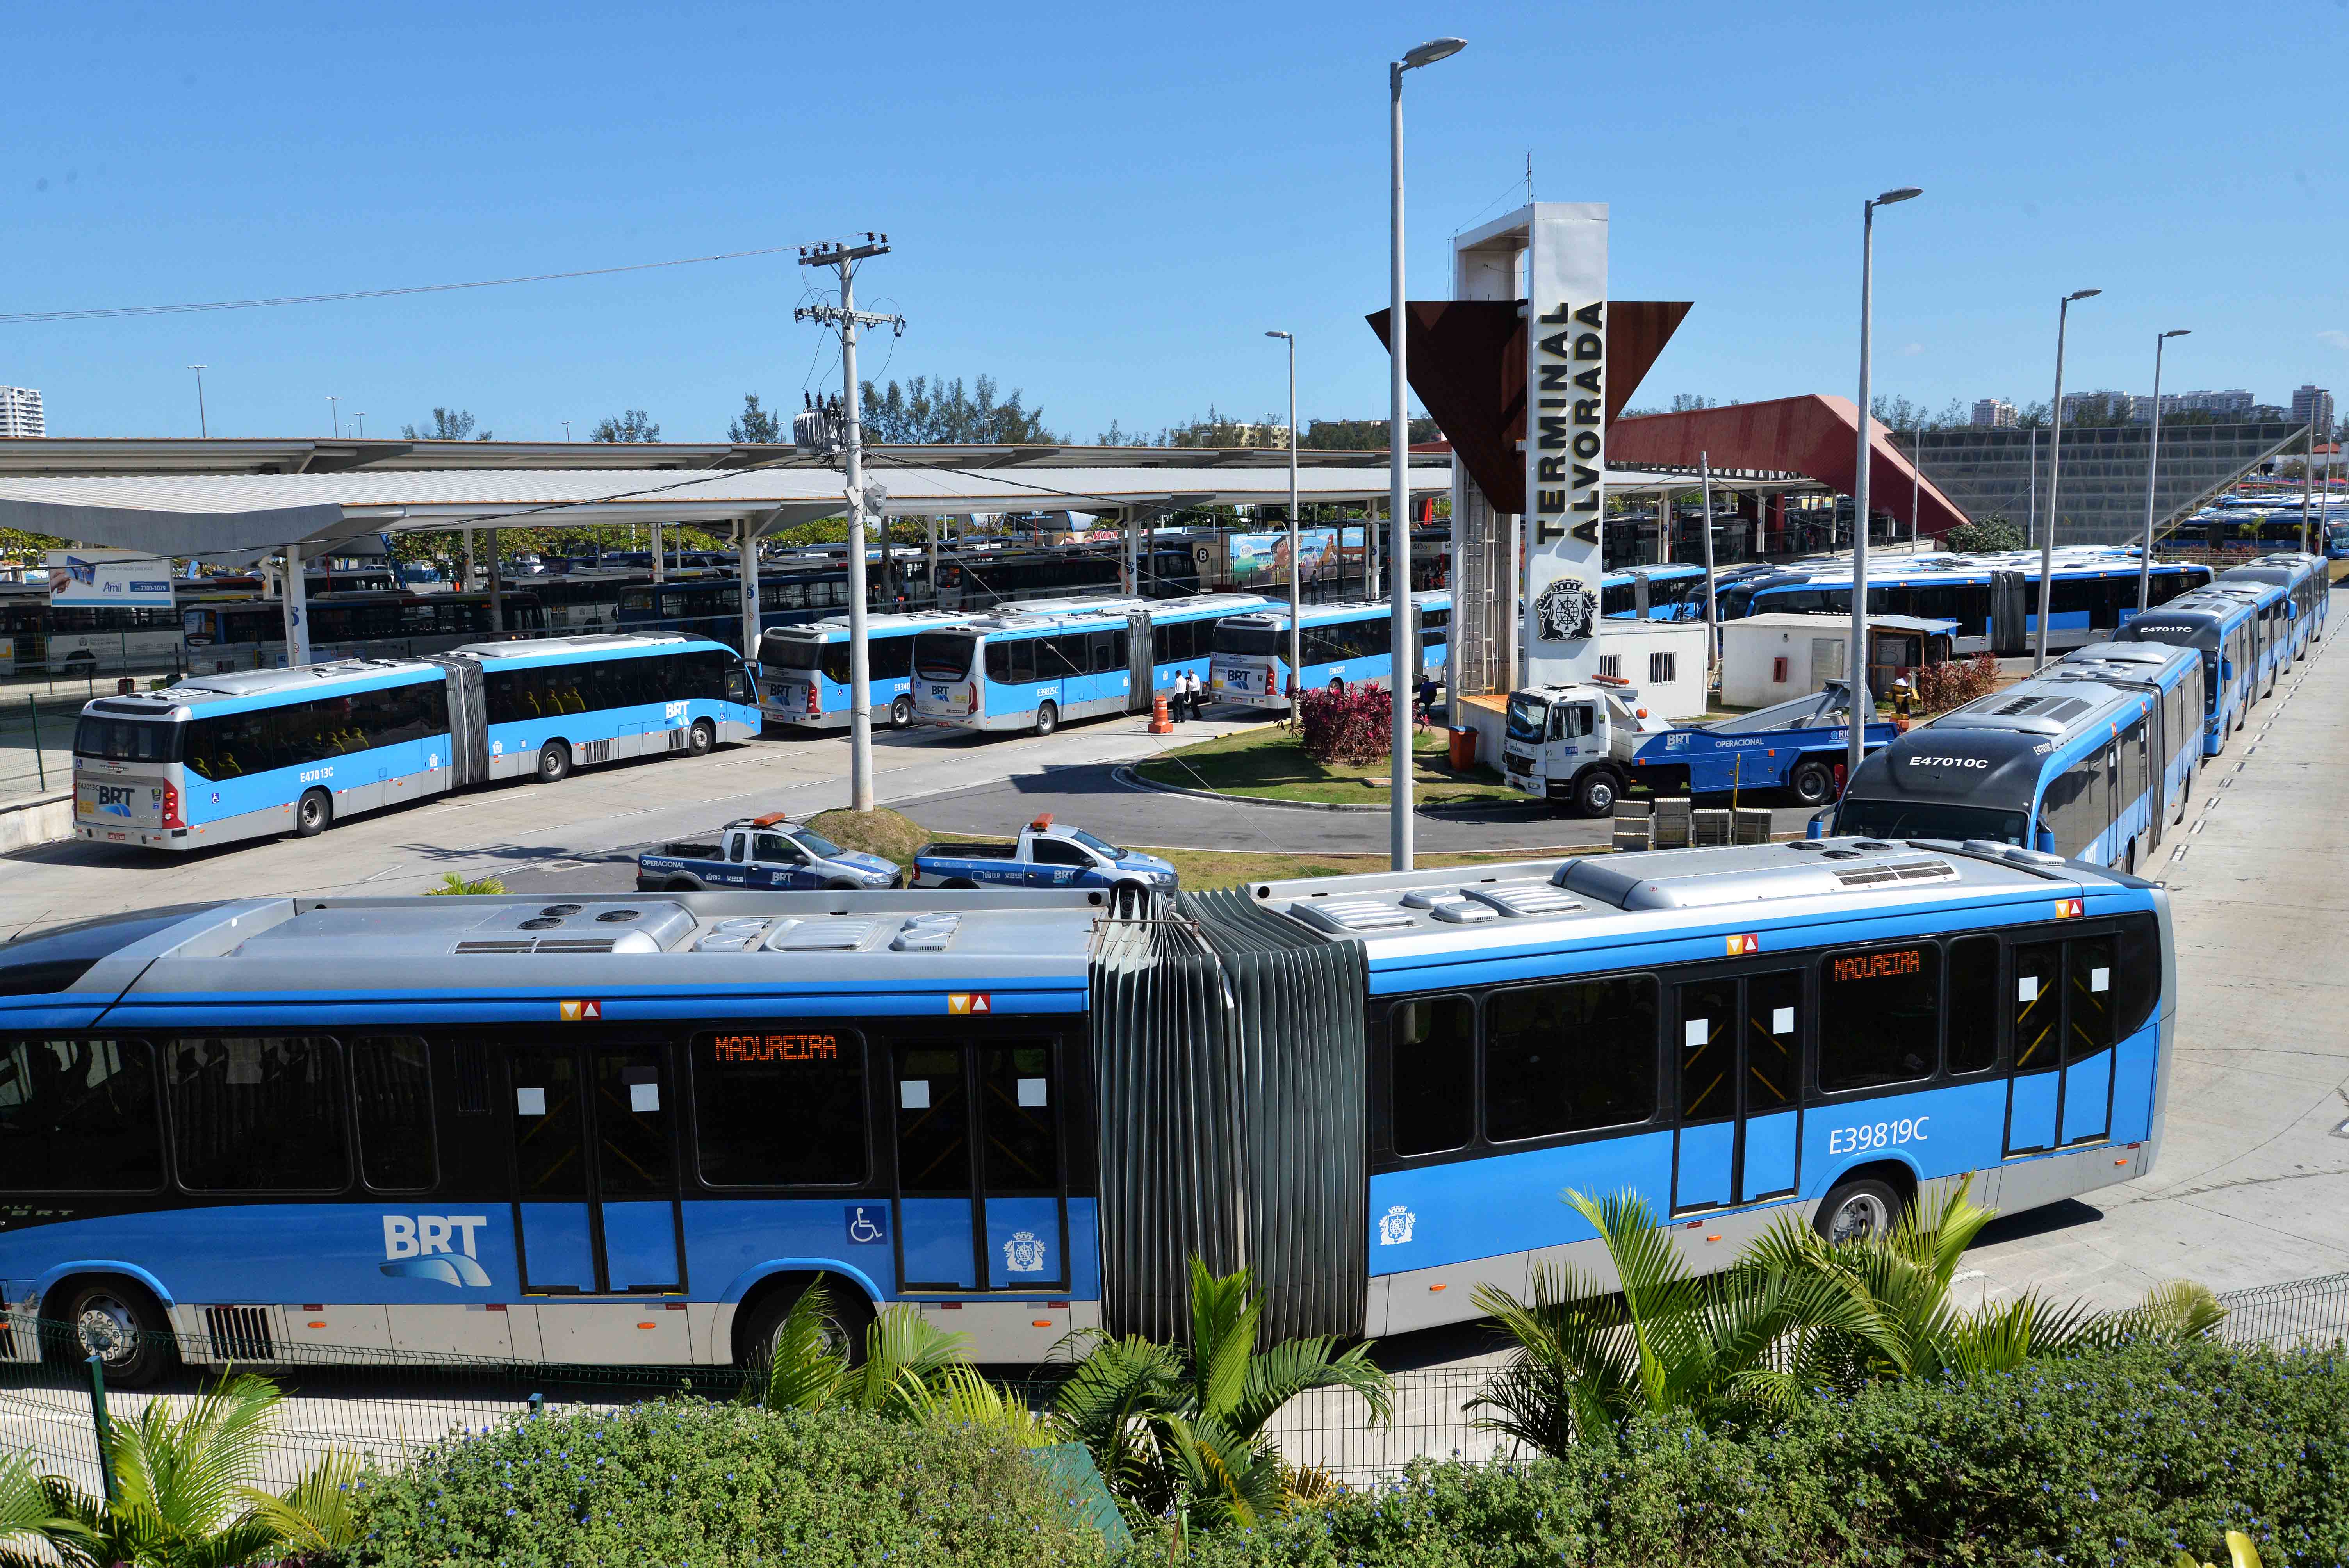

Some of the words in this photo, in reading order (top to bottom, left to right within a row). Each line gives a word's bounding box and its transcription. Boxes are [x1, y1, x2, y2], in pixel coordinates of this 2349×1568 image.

[1537, 302, 1568, 545] TERMINAL
[1571, 301, 1603, 546] ALVORADA
[1200, 550, 1207, 561] B
[103, 581, 122, 592] Amil
[1228, 669, 1251, 682] BRT
[770, 684, 792, 698] BRT
[932, 685, 949, 696] BRT
[1037, 686, 1059, 697] E39825C
[666, 701, 690, 719] BRT
[1667, 733, 1693, 746] BRT
[1715, 738, 1764, 748] OPERACIONAL
[2033, 742, 2053, 755] E47010C
[1909, 757, 1988, 768] E47010C
[300, 767, 333, 783] E47013C
[78, 782, 99, 791] E47013C
[99, 786, 135, 807] BRT
[642, 860, 684, 868] OPERACIONAL
[772, 872, 793, 883] BRT
[1054, 870, 1076, 880] BRT
[1835, 951, 1920, 981] MADUREIRA
[716, 1035, 836, 1061] MADUREIRA
[1829, 1116, 1930, 1155] E39819C
[383, 1215, 487, 1260] BRT
